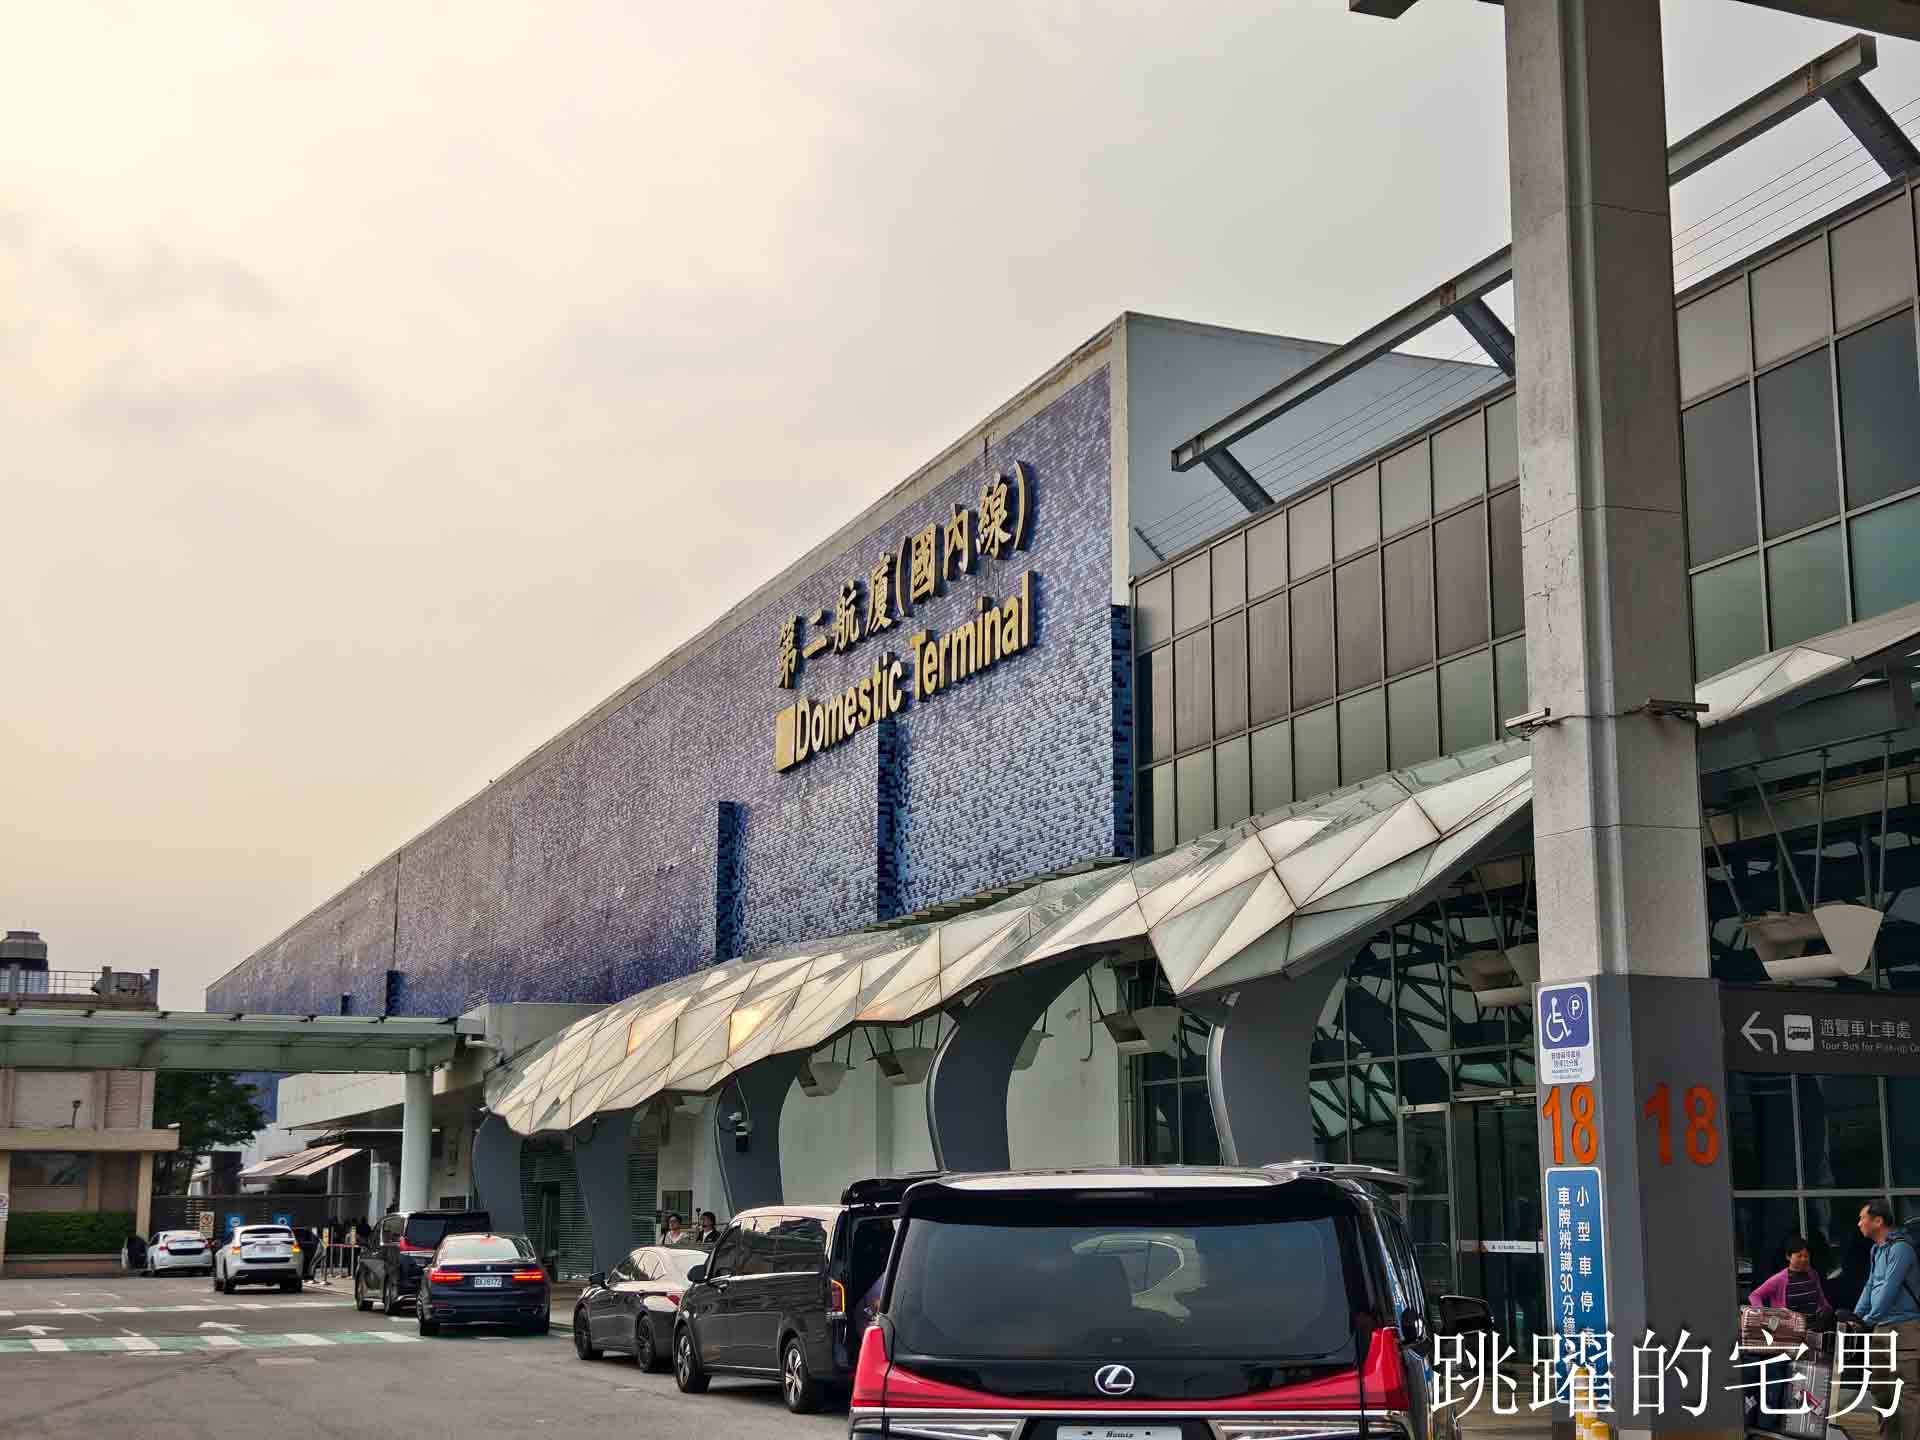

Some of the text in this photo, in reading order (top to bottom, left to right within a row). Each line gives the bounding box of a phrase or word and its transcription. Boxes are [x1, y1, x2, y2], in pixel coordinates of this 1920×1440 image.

[778, 460, 1028, 688] 第二航廈(國內線)
[796, 570, 1030, 760] Domestic Terminal
[1542, 1086, 1598, 1165] 18
[1644, 1082, 1719, 1165] 18
